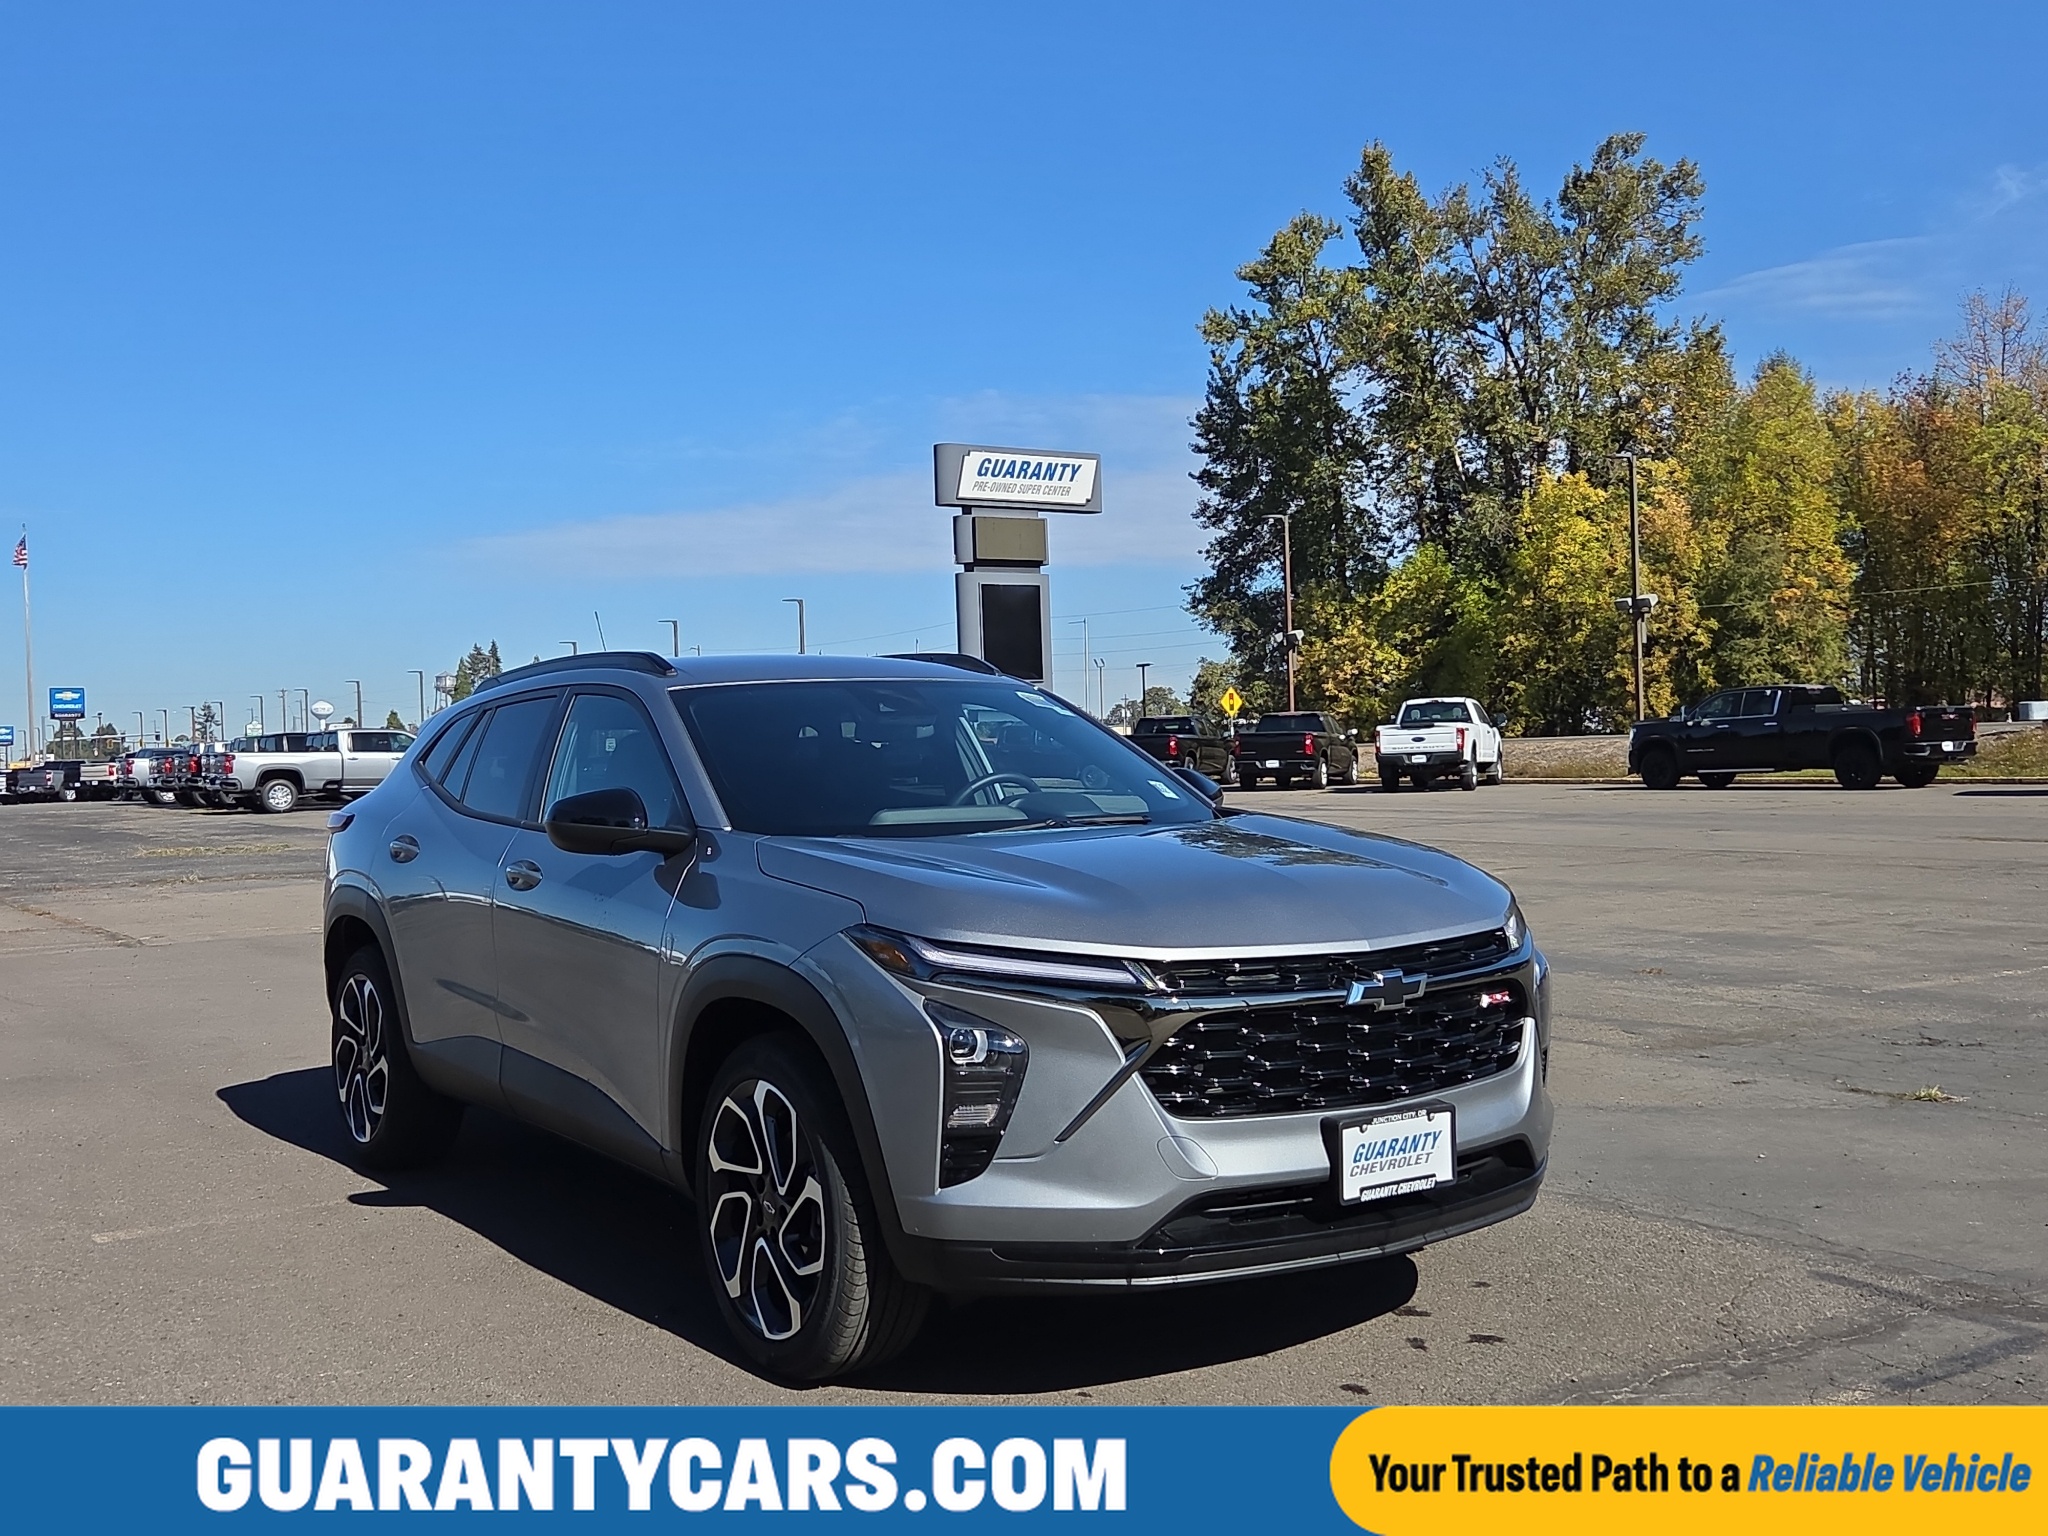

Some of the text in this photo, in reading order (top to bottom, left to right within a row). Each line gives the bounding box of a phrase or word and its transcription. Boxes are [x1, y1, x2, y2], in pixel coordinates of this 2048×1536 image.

[976, 457, 1083, 482] GUARANTY
[972, 480, 1072, 497] PRE-OWNED SUPER CENTER
[1352, 1130, 1442, 1164] GUARANTY
[1350, 1151, 1434, 1178] CHEVROLET
[1397, 1178, 1436, 1194] CHEVROLET
